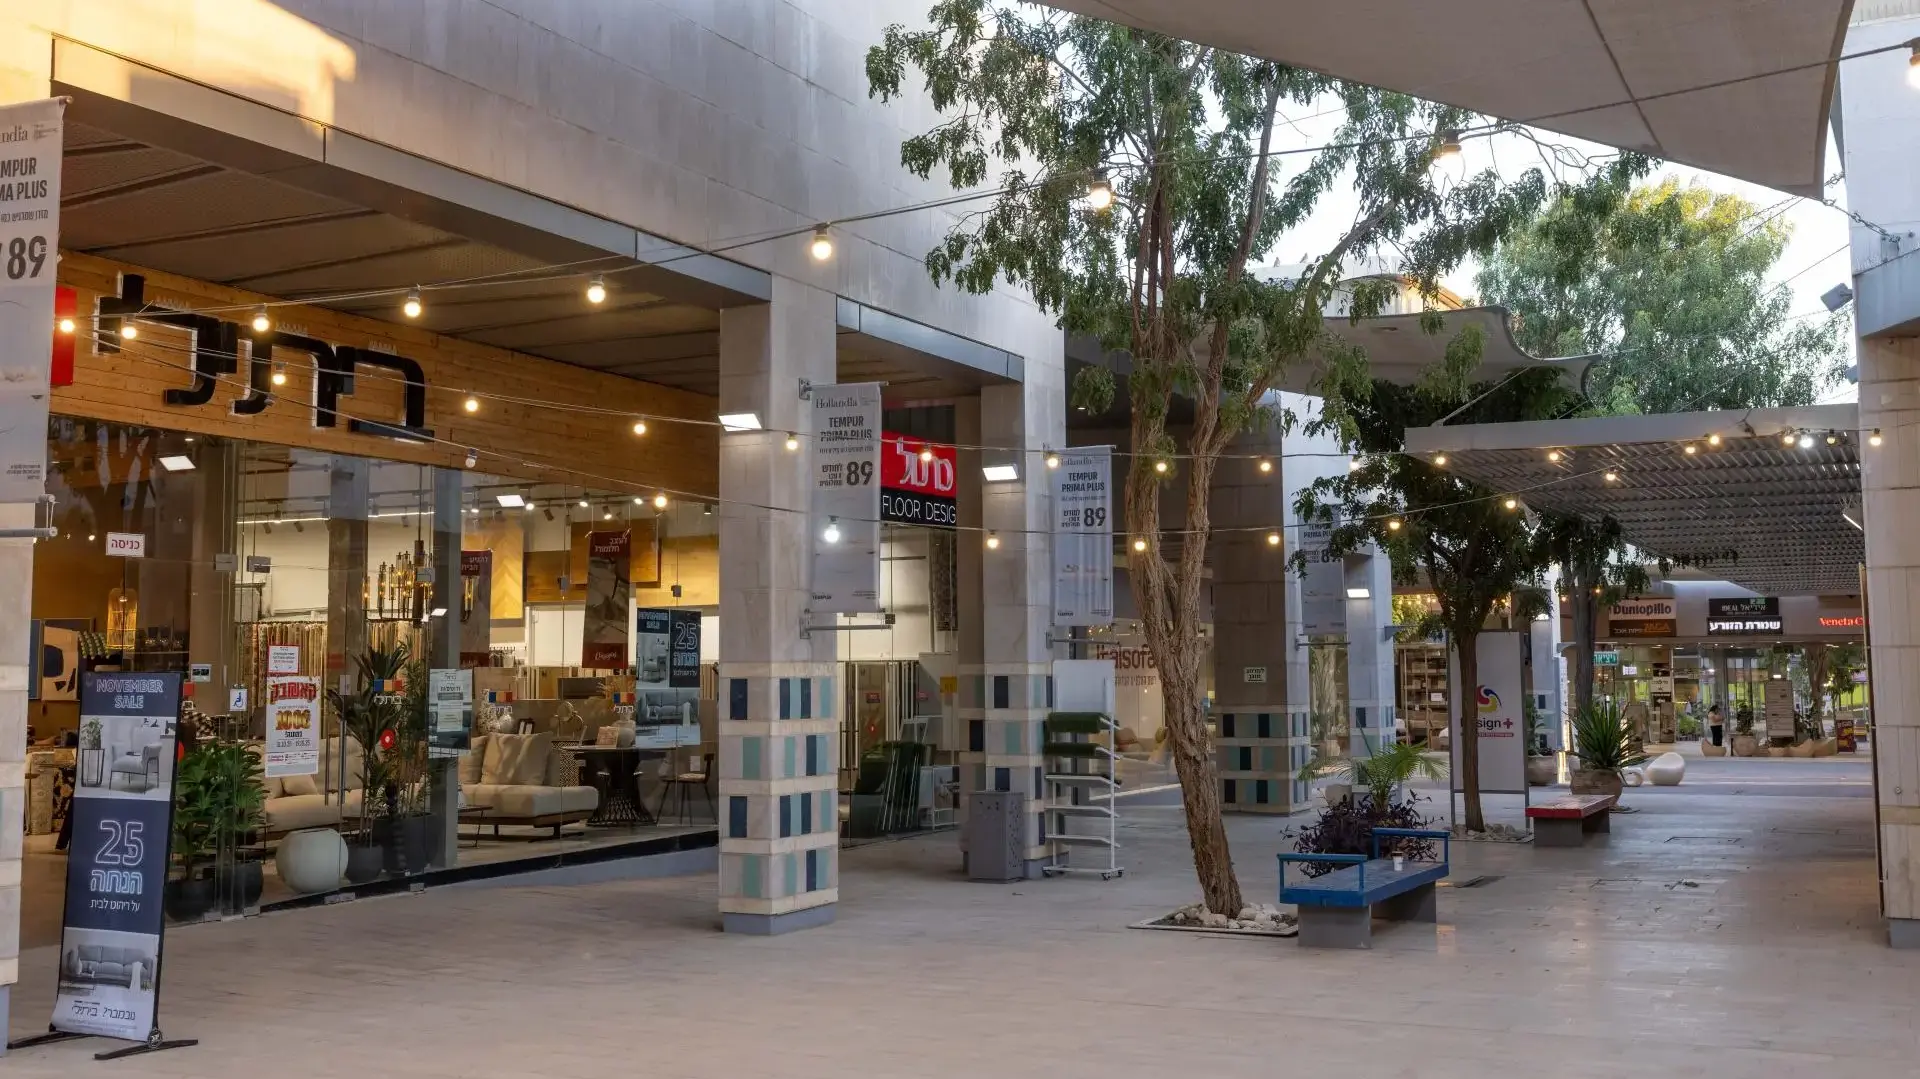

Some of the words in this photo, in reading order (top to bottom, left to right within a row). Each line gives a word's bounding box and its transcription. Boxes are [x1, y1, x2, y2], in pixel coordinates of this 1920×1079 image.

[17, 180, 48, 200] PLUS
[828, 415, 864, 428] TEMPUR
[1068, 472, 1098, 482] TEMPUR
[1061, 484, 1086, 493] PRIMA
[1087, 482, 1105, 492] PLUS
[882, 495, 921, 518] FLOOR
[1083, 507, 1106, 527] 89
[111, 538, 140, 550] כניסה
[1709, 621, 1744, 632] הזורע
[1744, 621, 1781, 630] שמרת
[1819, 617, 1854, 626] Veneta
[96, 679, 164, 693] NOVEMBER
[114, 695, 144, 709] SALE
[90, 869, 143, 895] הנחה
[91, 898, 109, 909] לבית
[110, 900, 131, 911] ריהוט
[132, 901, 141, 912] על
